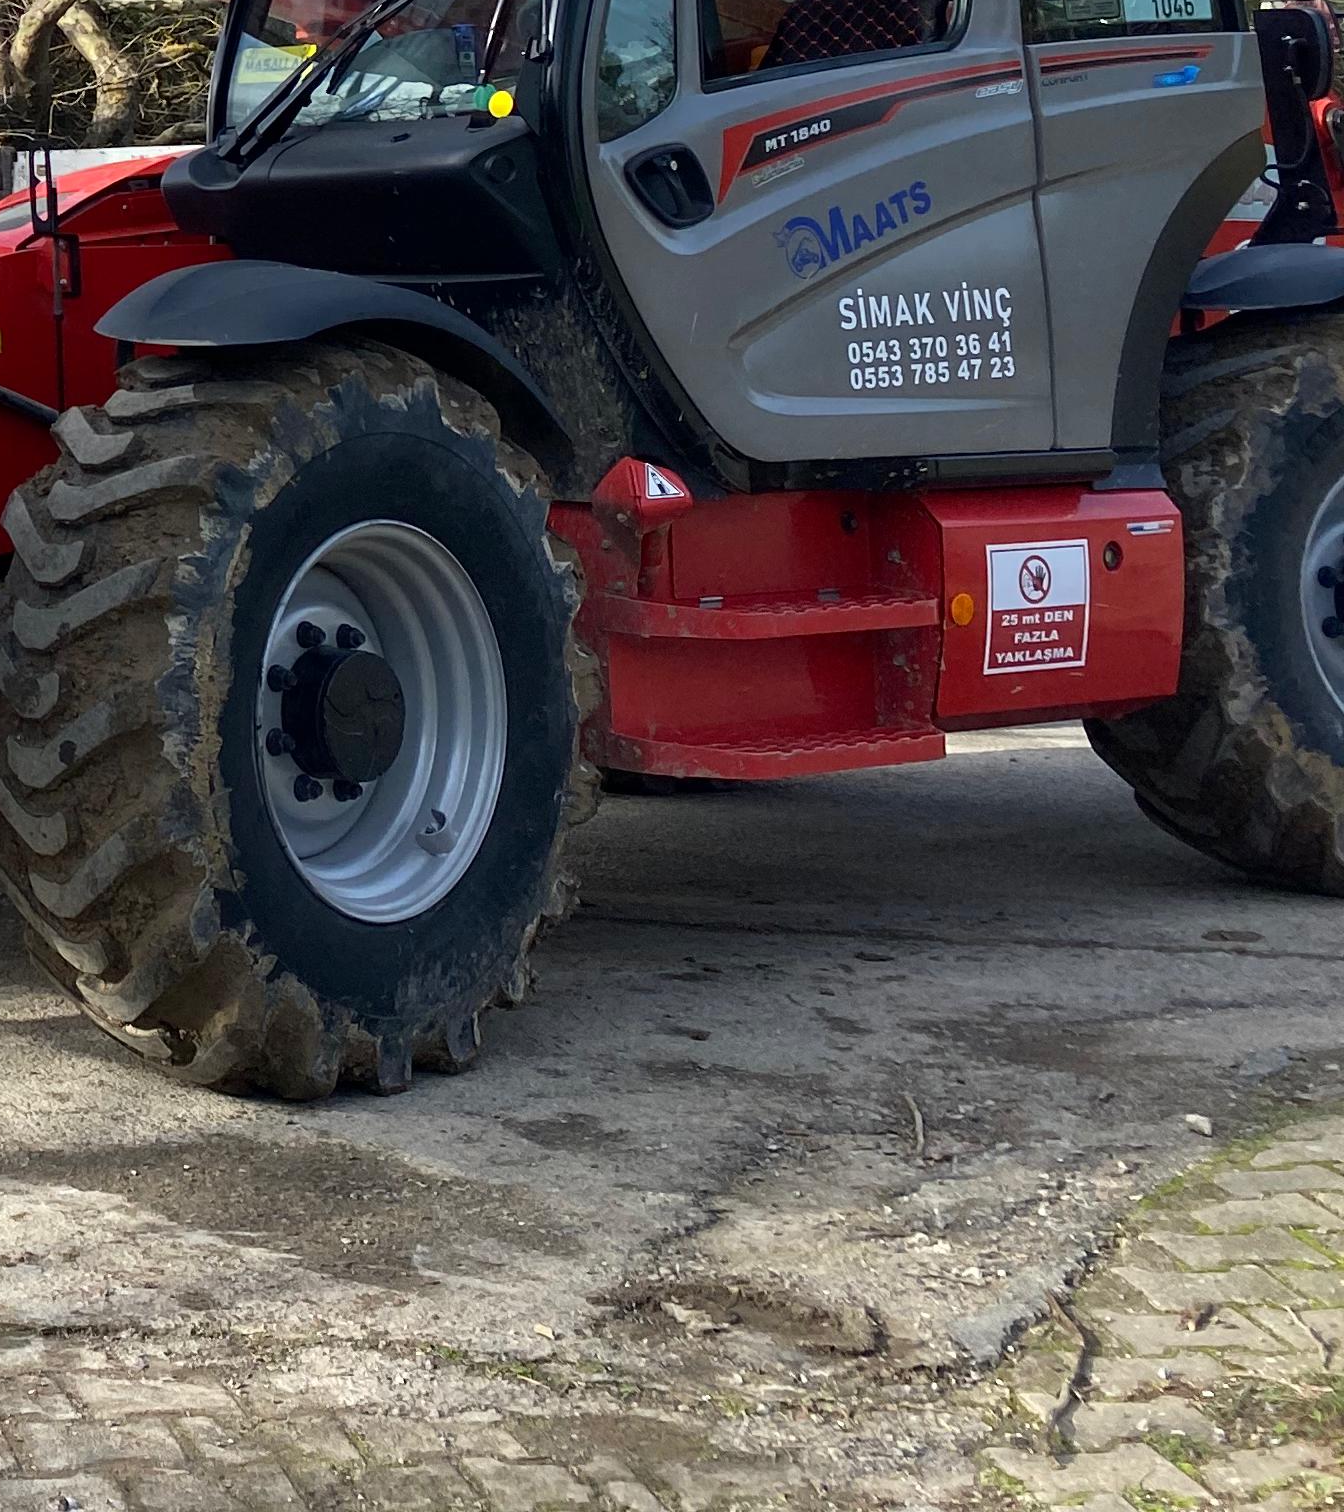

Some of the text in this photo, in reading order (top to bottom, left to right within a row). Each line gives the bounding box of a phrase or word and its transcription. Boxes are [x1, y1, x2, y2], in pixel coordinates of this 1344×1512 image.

[764, 119, 831, 153] MT 1840
[784, 180, 932, 270] MAATS
[838, 281, 1013, 330] SİMAK VİNÇ
[847, 331, 1012, 364] 0543 370 36 41
[850, 356, 1016, 390] 0553 785 47 23
[1000, 609, 1074, 627] 25 mt DEN
[1014, 629, 1060, 645] FAZLA
[995, 646, 1074, 664] YAKLAŞMA
